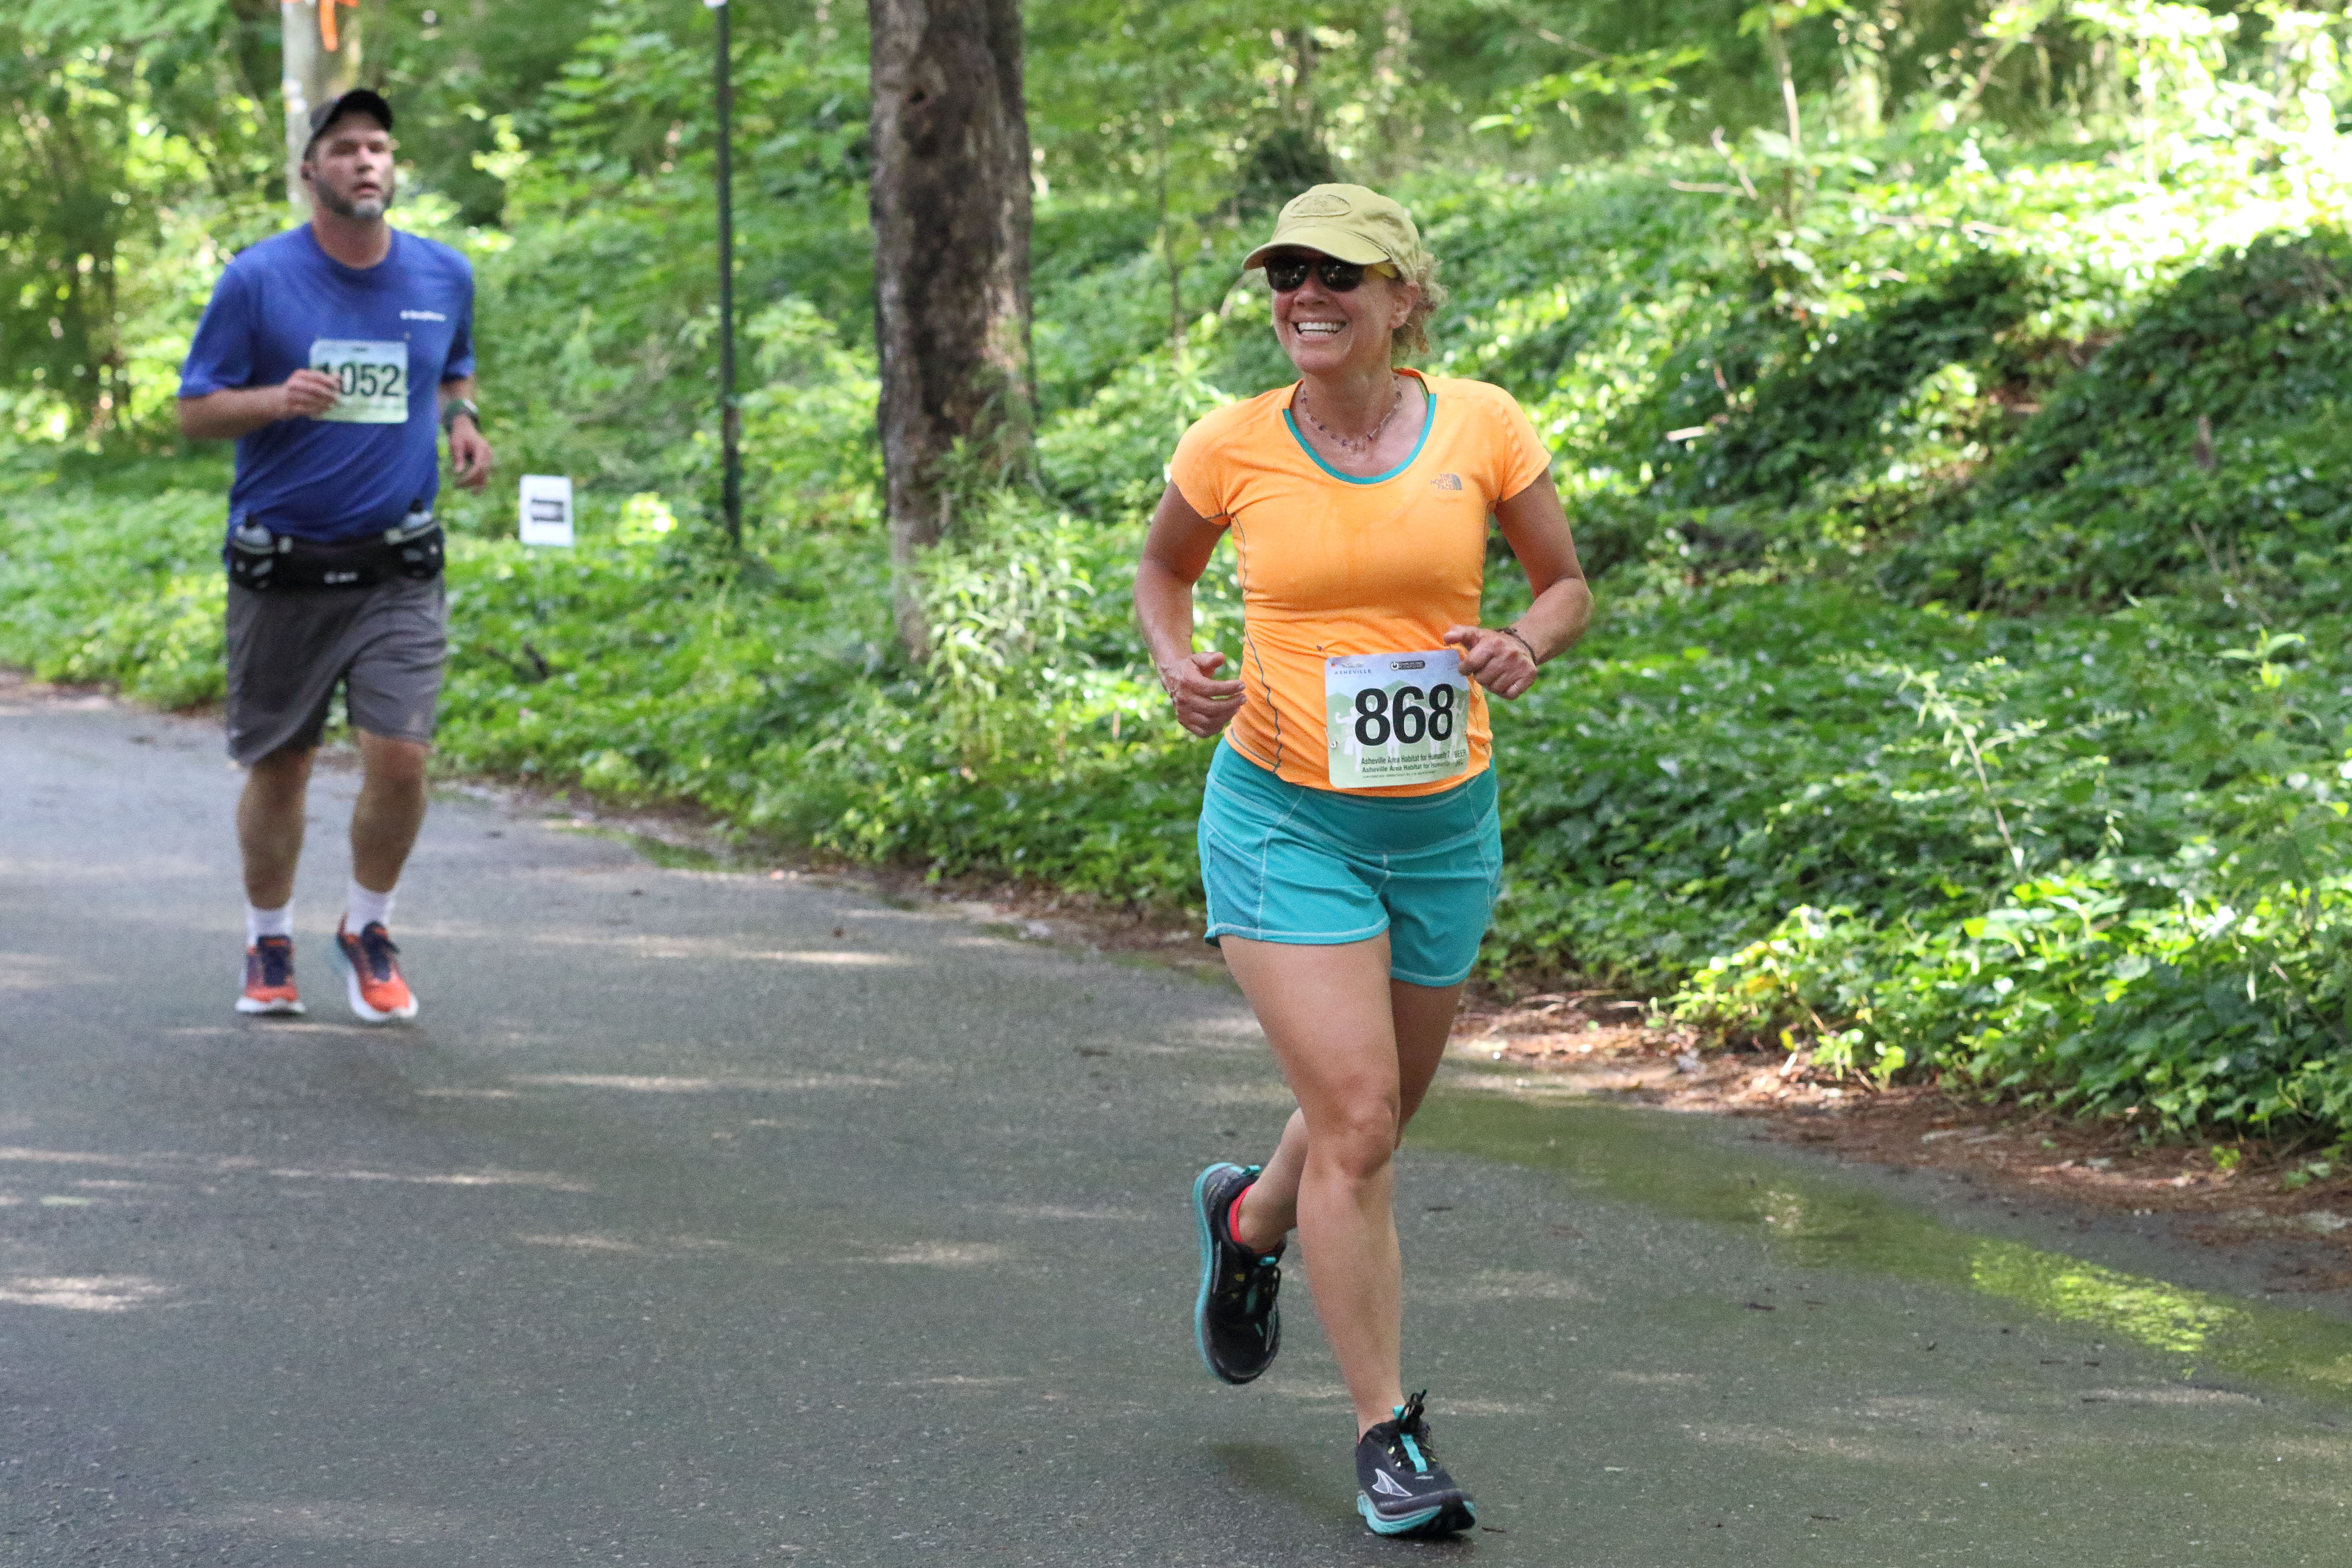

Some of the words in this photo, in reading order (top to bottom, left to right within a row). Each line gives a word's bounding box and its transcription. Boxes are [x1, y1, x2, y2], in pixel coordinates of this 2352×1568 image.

[1355, 683, 1454, 746] 868
[1401, 754, 1419, 763] Habitat
[1454, 749, 1467, 758] BEER
